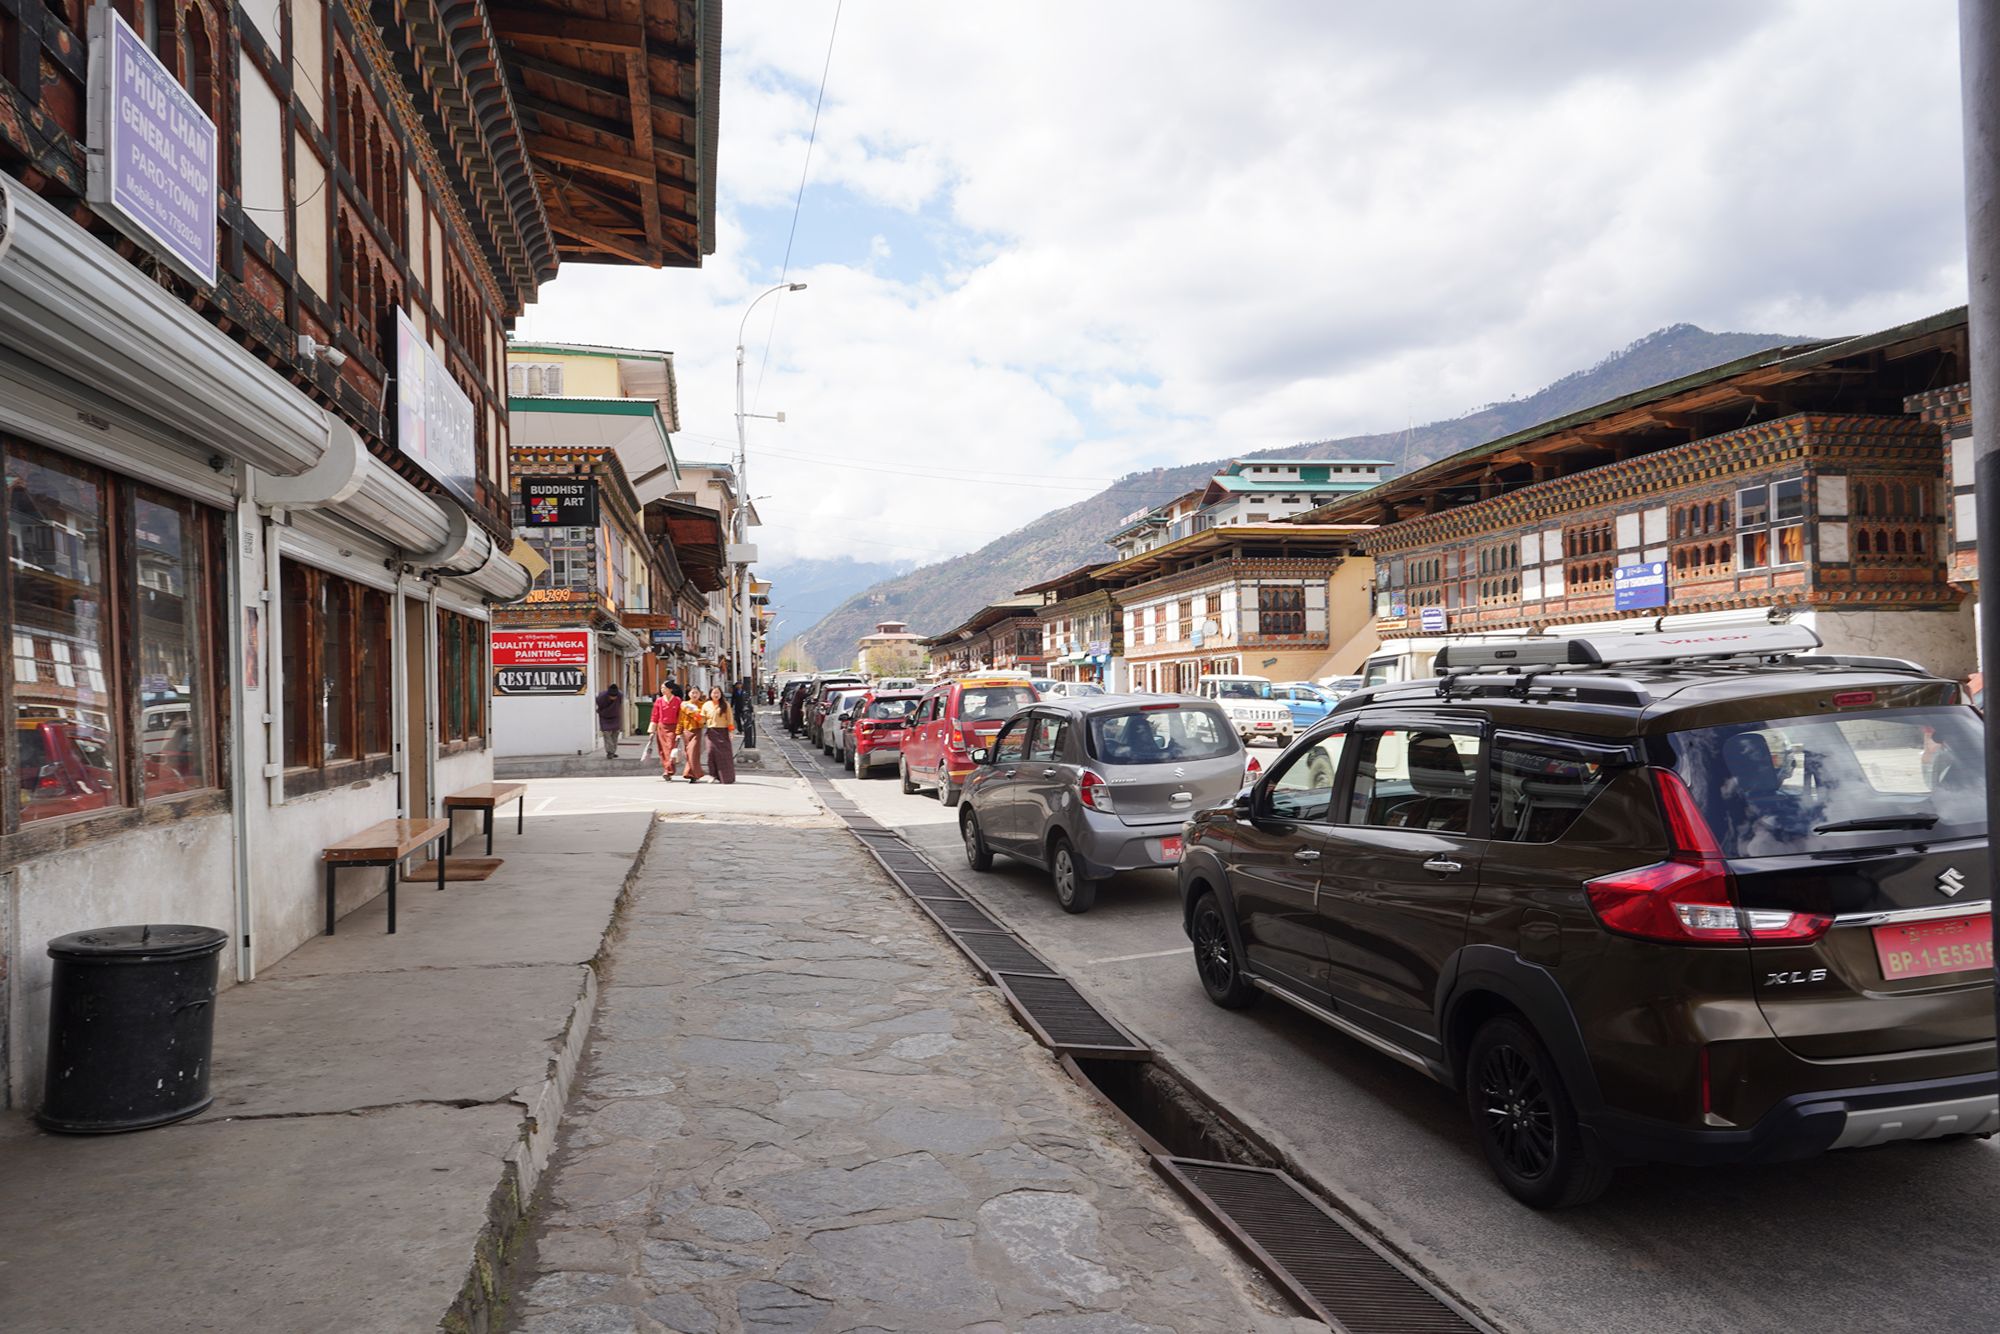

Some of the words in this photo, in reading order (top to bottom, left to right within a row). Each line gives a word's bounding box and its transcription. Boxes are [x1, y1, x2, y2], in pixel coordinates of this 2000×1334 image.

[124, 53, 166, 121] PHUB
[170, 103, 207, 165] LHAM
[121, 95, 178, 171] GENERAL
[180, 154, 208, 198] SHOP
[131, 144, 198, 222] PARO:TOWN
[126, 174, 155, 210] Mobile
[155, 200, 167, 221] No
[530, 485, 584, 495] BUDDHIST
[563, 497, 584, 506] ART
[492, 641, 535, 649] QUALITY
[537, 640, 584, 649] THANGKA
[515, 650, 562, 658] PAINTING
[499, 671, 583, 686] RESTAURANT
[1763, 968, 1827, 985] XL6
